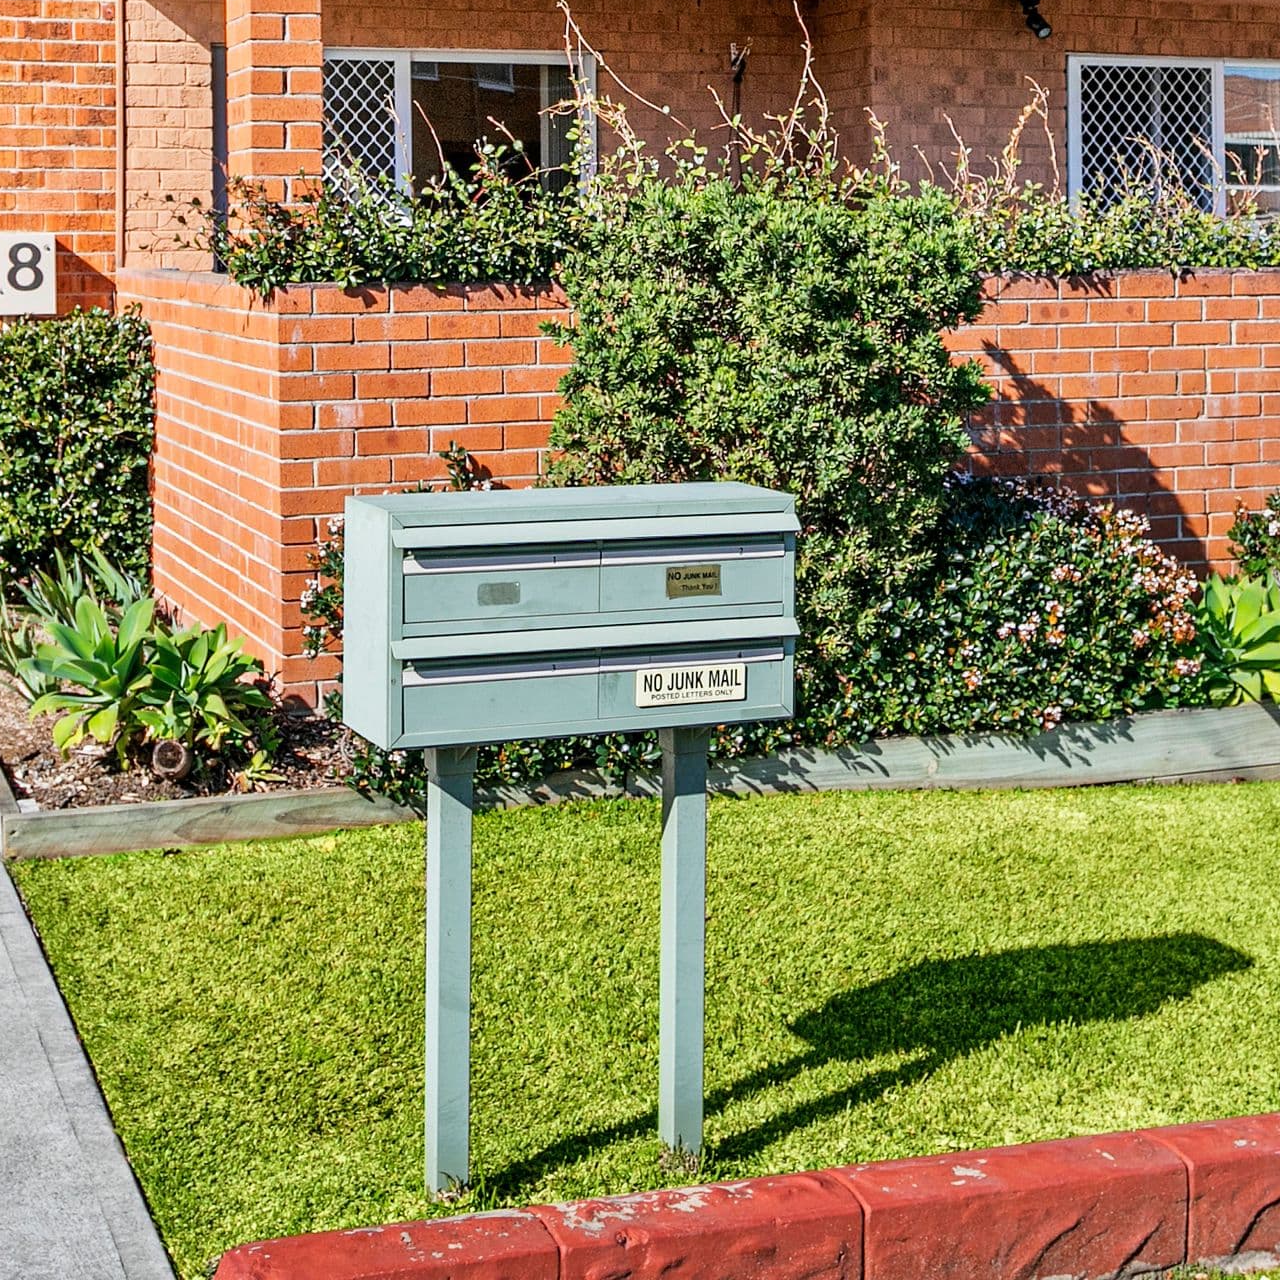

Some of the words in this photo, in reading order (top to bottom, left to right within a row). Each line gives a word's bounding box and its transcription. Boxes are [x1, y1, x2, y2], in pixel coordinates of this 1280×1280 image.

[7, 242, 44, 291] 8
[667, 571, 682, 581] NO
[683, 572, 701, 580] JUNK
[643, 673, 663, 692] NO
[667, 670, 704, 691] JUNK
[708, 669, 742, 688] MAIL
[651, 692, 681, 700] POSTED
[681, 690, 713, 699] LETTERS
[714, 688, 734, 696] ONLY
